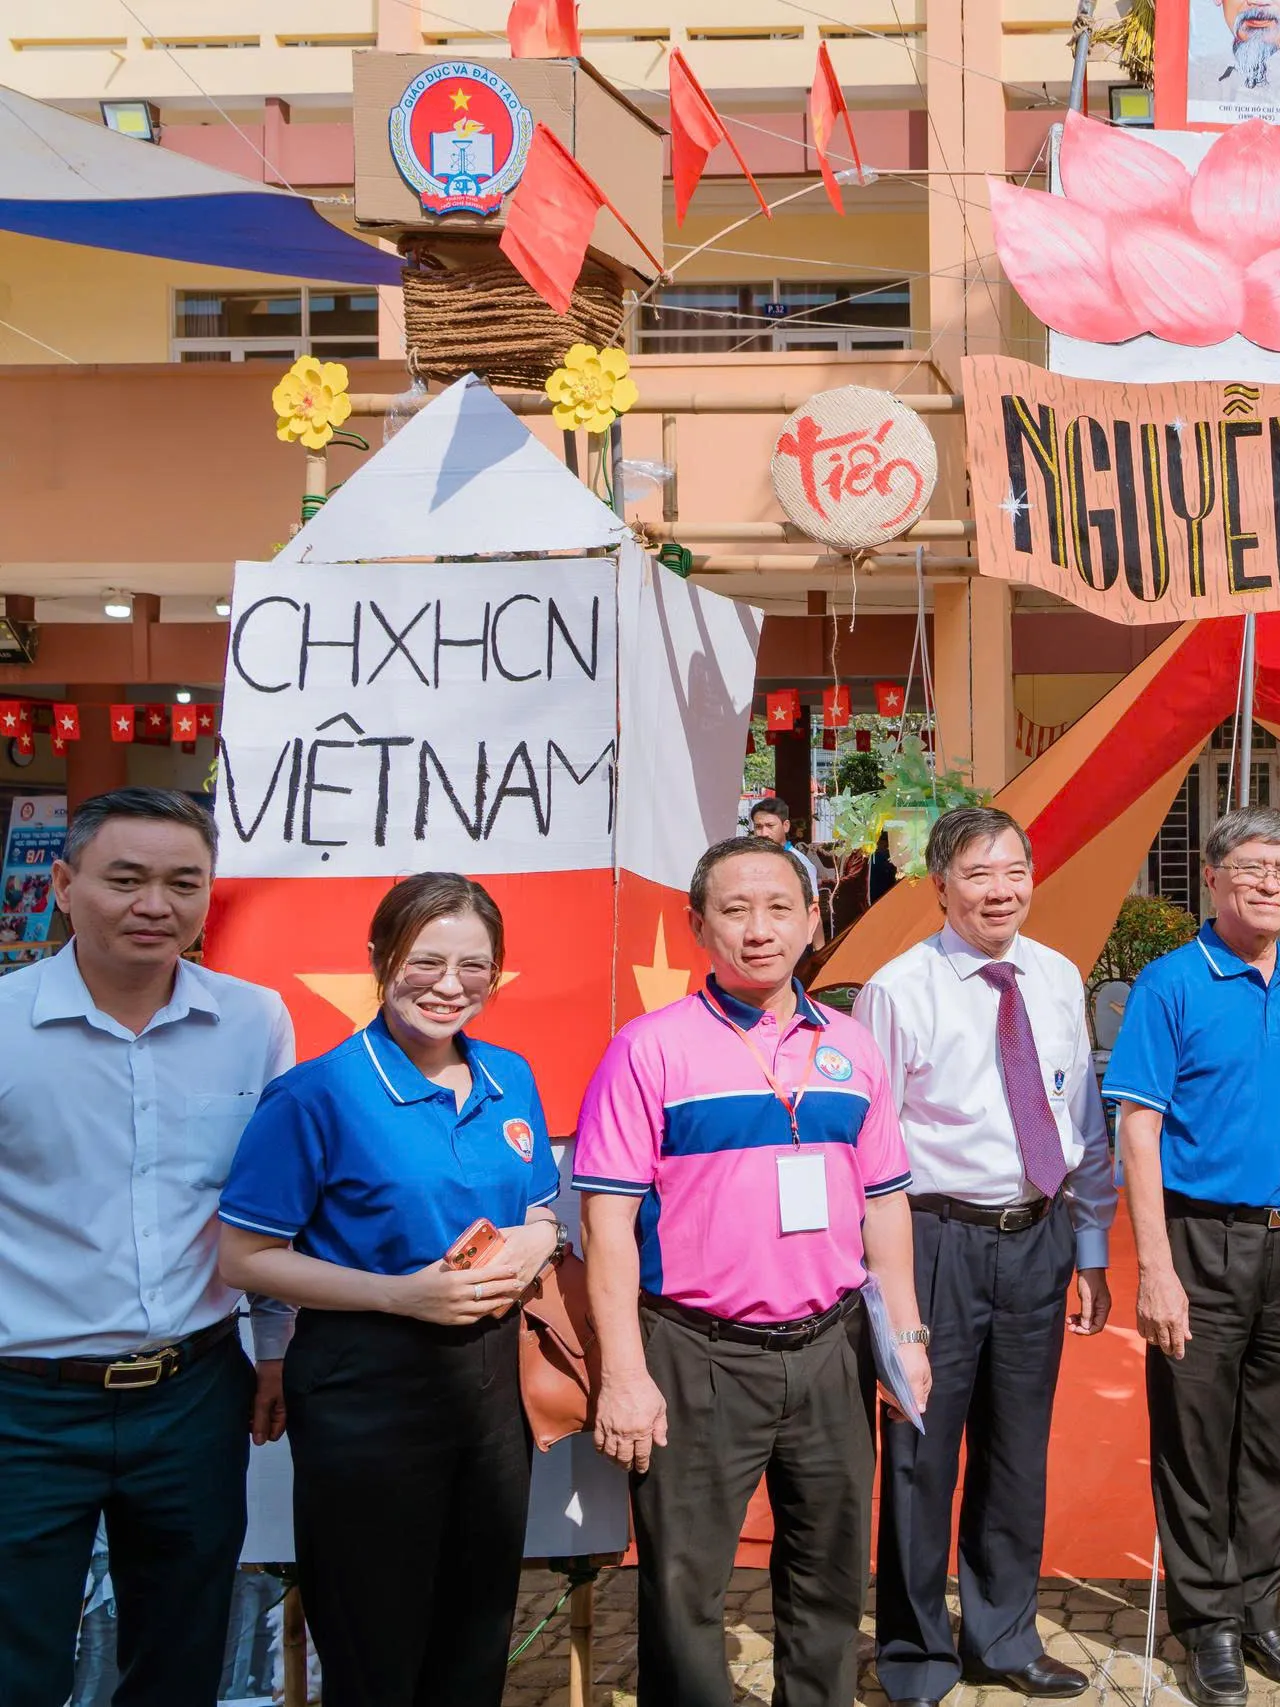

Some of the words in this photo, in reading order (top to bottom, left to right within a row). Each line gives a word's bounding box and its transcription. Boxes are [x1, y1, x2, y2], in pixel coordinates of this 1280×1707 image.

[404, 80, 425, 109] GIÁO
[425, 66, 451, 83] DỤC
[452, 64, 468, 75] VÀ
[472, 68, 498, 87] ĐÀO
[499, 85, 518, 109] TẠO
[767, 305, 785, 314] P.32
[776, 415, 924, 530] Tiến
[232, 593, 600, 694] CHXHCN
